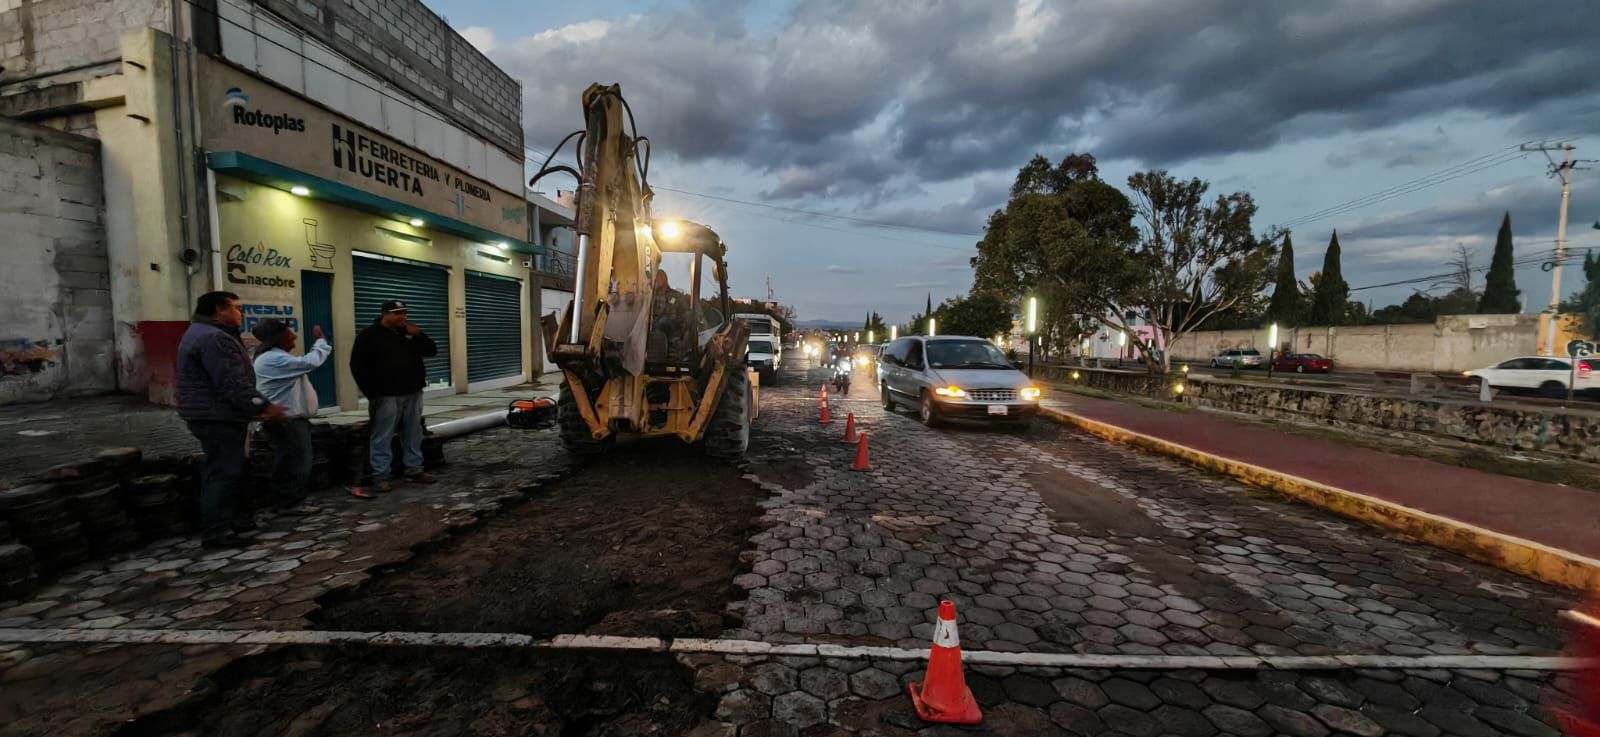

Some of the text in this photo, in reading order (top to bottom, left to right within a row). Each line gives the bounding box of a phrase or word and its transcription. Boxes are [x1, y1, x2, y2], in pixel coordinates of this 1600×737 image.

[233, 104, 305, 134] Rotoplas
[358, 134, 492, 203] FERRETERIA Y PLOMERIA
